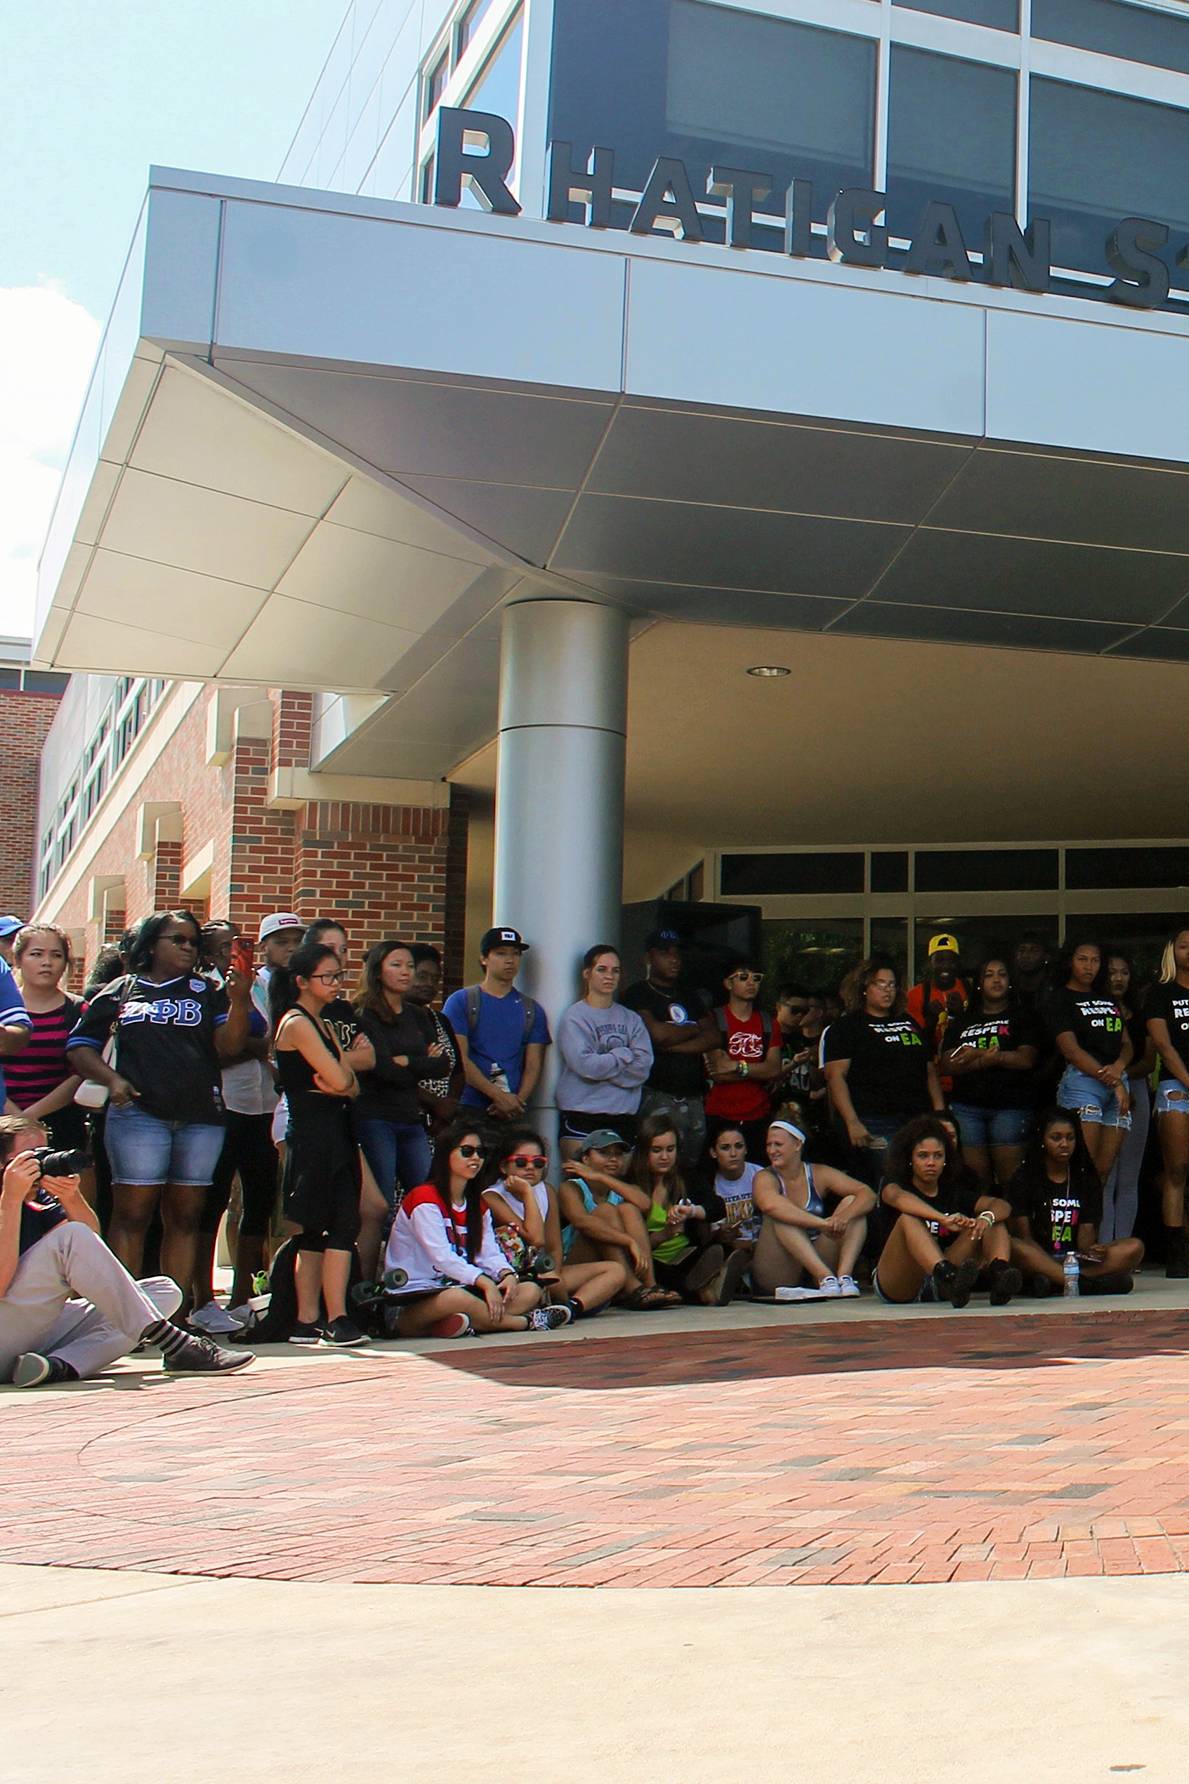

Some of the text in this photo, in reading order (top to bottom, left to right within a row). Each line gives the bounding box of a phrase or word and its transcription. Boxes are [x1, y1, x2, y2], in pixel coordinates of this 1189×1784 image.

[434, 106, 1051, 293] RHATIGAN
[1172, 999, 1189, 1007] PUT
[1091, 1017, 1122, 1032] ON EA
[900, 1032, 922, 1046] EA
